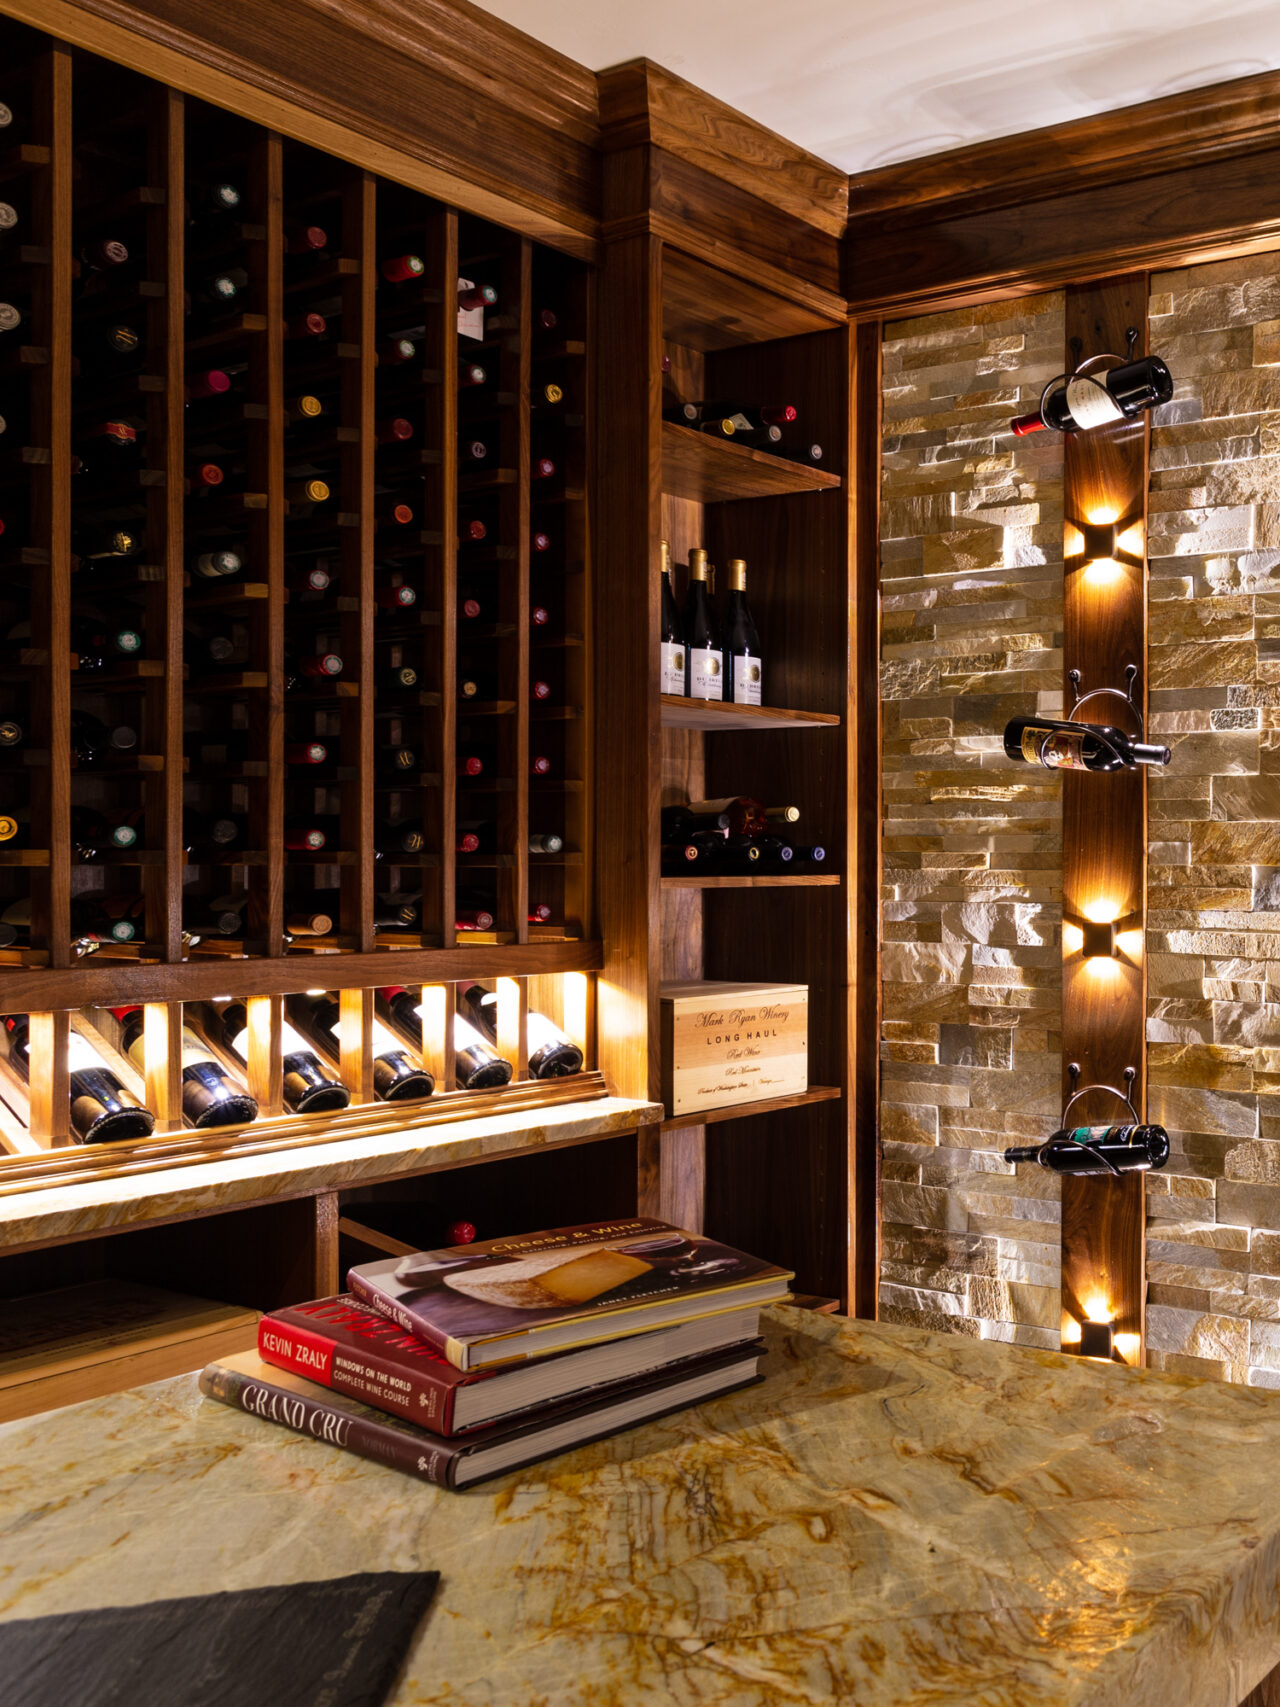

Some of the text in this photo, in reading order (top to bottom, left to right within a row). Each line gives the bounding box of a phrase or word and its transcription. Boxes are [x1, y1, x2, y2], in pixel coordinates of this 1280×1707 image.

[694, 1004, 790, 1028] Mark Ryan Winery
[707, 1028, 777, 1046] LONG HAUL
[727, 1045, 761, 1060] Red Wine
[491, 1222, 643, 1252] Cheese & Wine
[597, 1286, 680, 1307] JANET FLETCHER
[372, 1293, 393, 1318] Cheese
[391, 1308, 398, 1322] &
[398, 1311, 413, 1333] Wine
[263, 1333, 328, 1371] KEVIN ZRALY
[334, 1370, 410, 1407] COMPLETE WINE COURSE
[335, 1357, 412, 1392] WINDOWS ON THE WORLD
[242, 1384, 354, 1447] GRAND CRU
